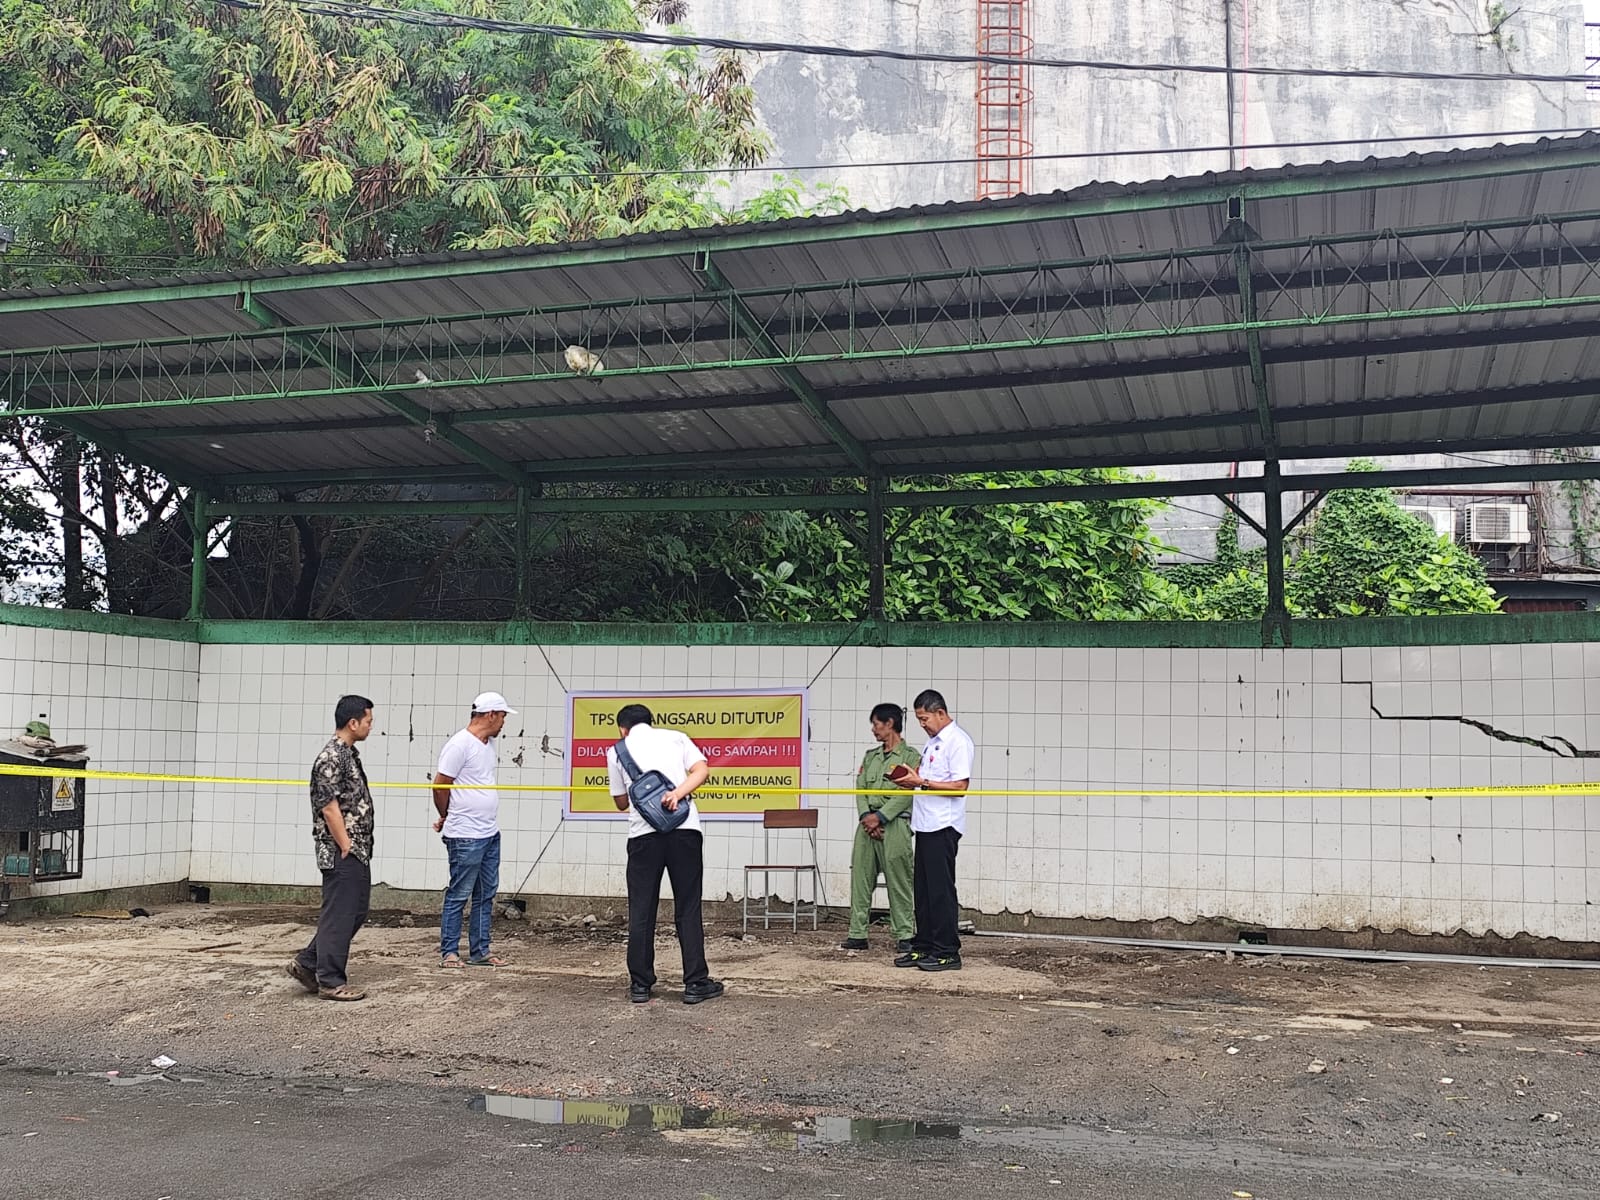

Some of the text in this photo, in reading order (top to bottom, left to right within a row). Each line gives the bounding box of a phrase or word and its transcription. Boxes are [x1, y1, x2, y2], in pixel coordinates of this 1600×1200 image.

[590, 711, 785, 726] TPS ANGSARU DITUTUP
[724, 745, 777, 757] SAMPAH
[782, 744, 796, 756] !!!
[722, 775, 792, 786] MEMBUANG
